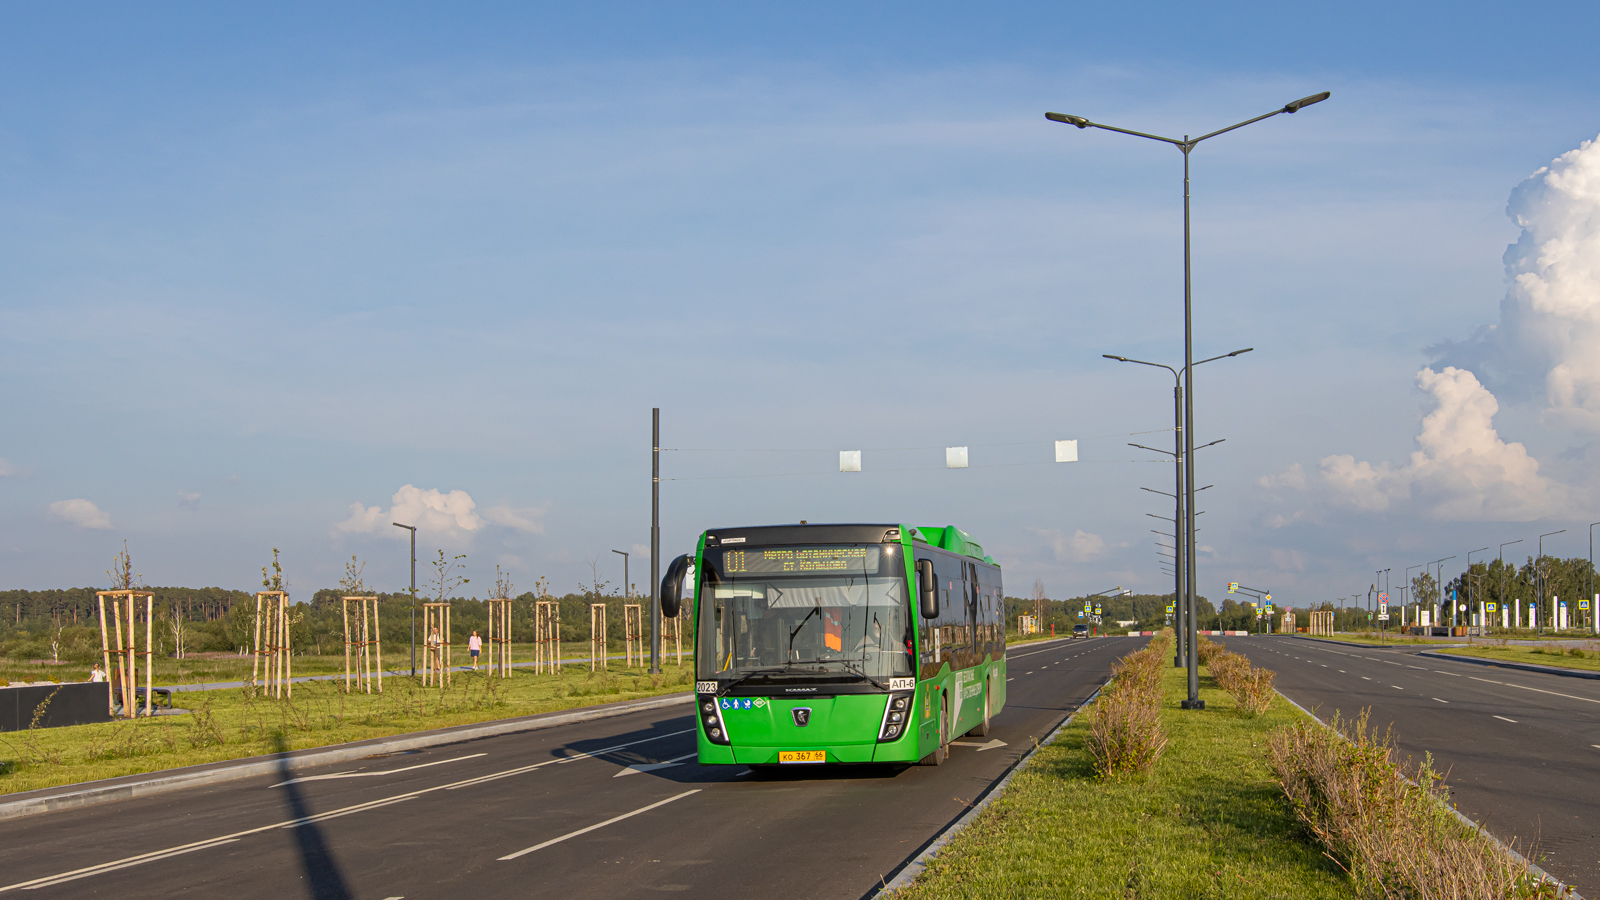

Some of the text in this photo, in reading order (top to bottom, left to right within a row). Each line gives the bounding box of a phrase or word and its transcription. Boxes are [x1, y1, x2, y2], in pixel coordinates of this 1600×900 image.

[727, 550, 747, 572] 01
[697, 682, 717, 693] 2023
[891, 679, 914, 689] АП-6
[796, 752, 811, 760] 367
